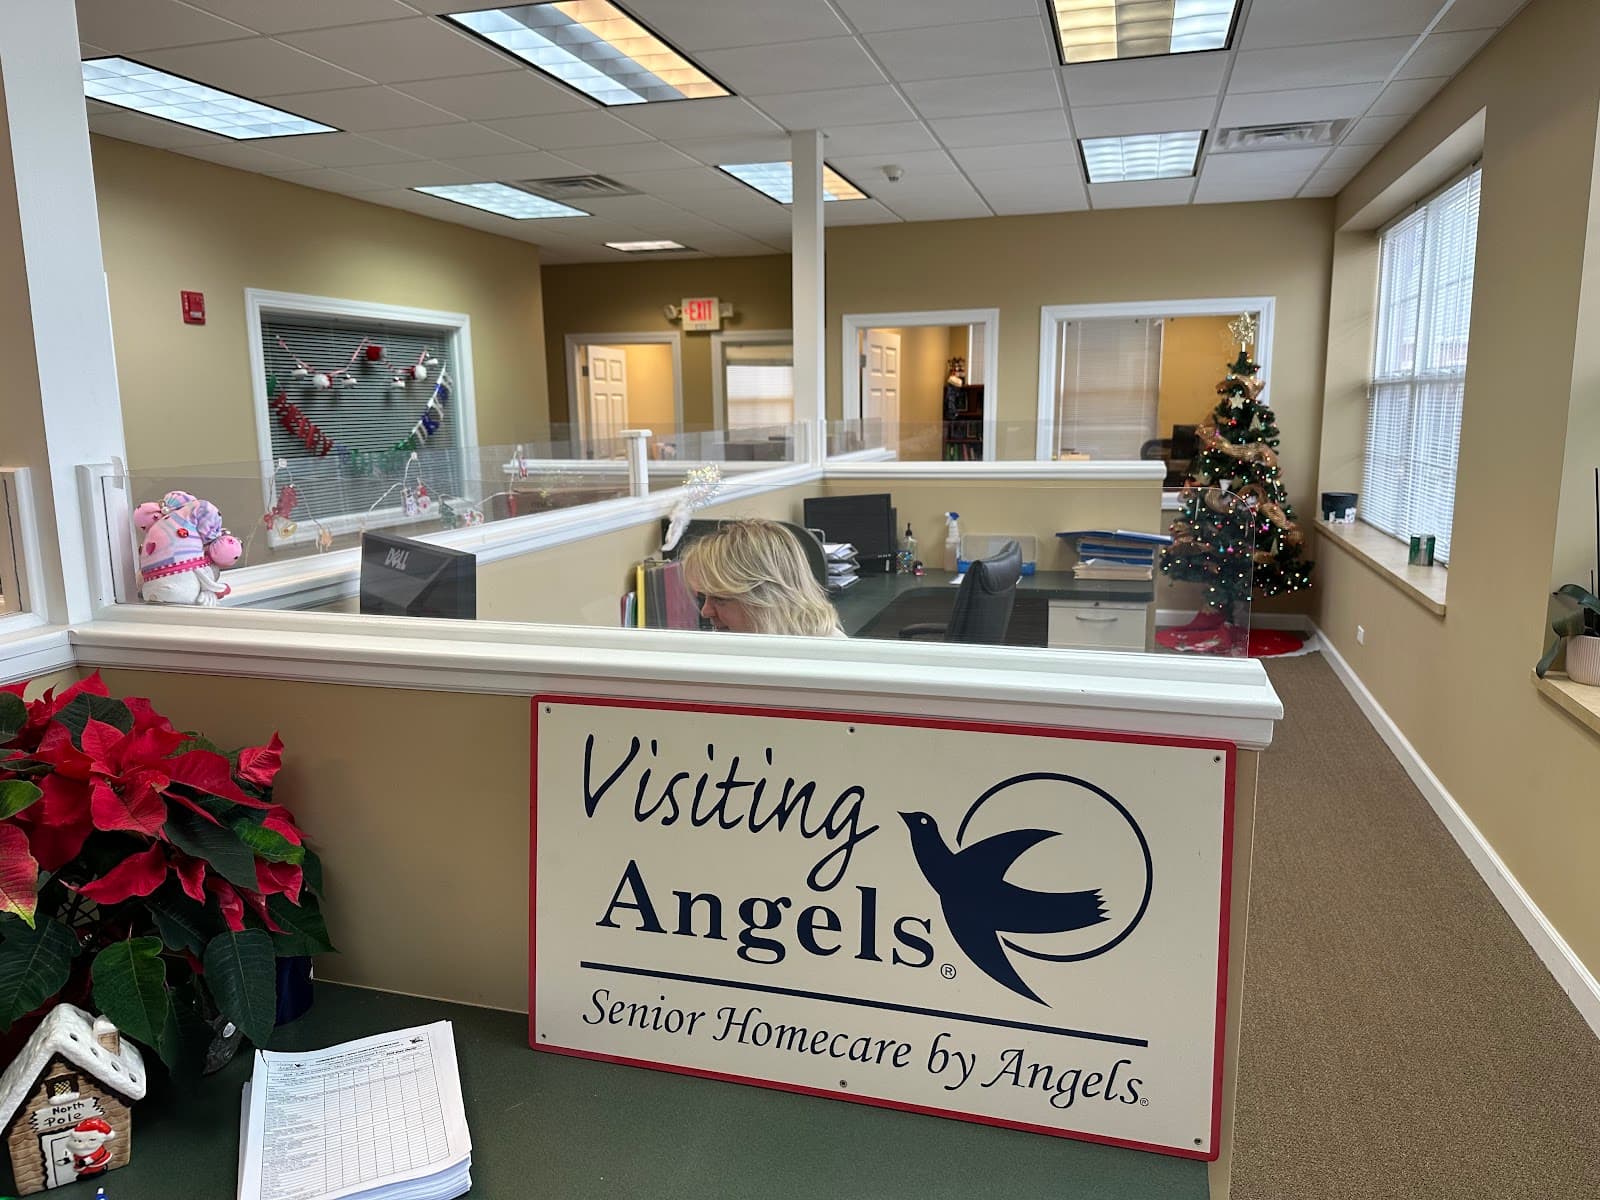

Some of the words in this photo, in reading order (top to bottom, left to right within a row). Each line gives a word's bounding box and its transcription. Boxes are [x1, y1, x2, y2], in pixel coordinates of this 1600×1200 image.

[688, 300, 714, 321] EXIT
[384, 547, 409, 571] DELL
[583, 733, 880, 893] Visiting
[582, 988, 706, 1037] Senior
[711, 1005, 912, 1068] Homecare
[927, 1032, 977, 1091] by
[43, 1112, 82, 1127] Pole
[52, 1102, 85, 1115] North
